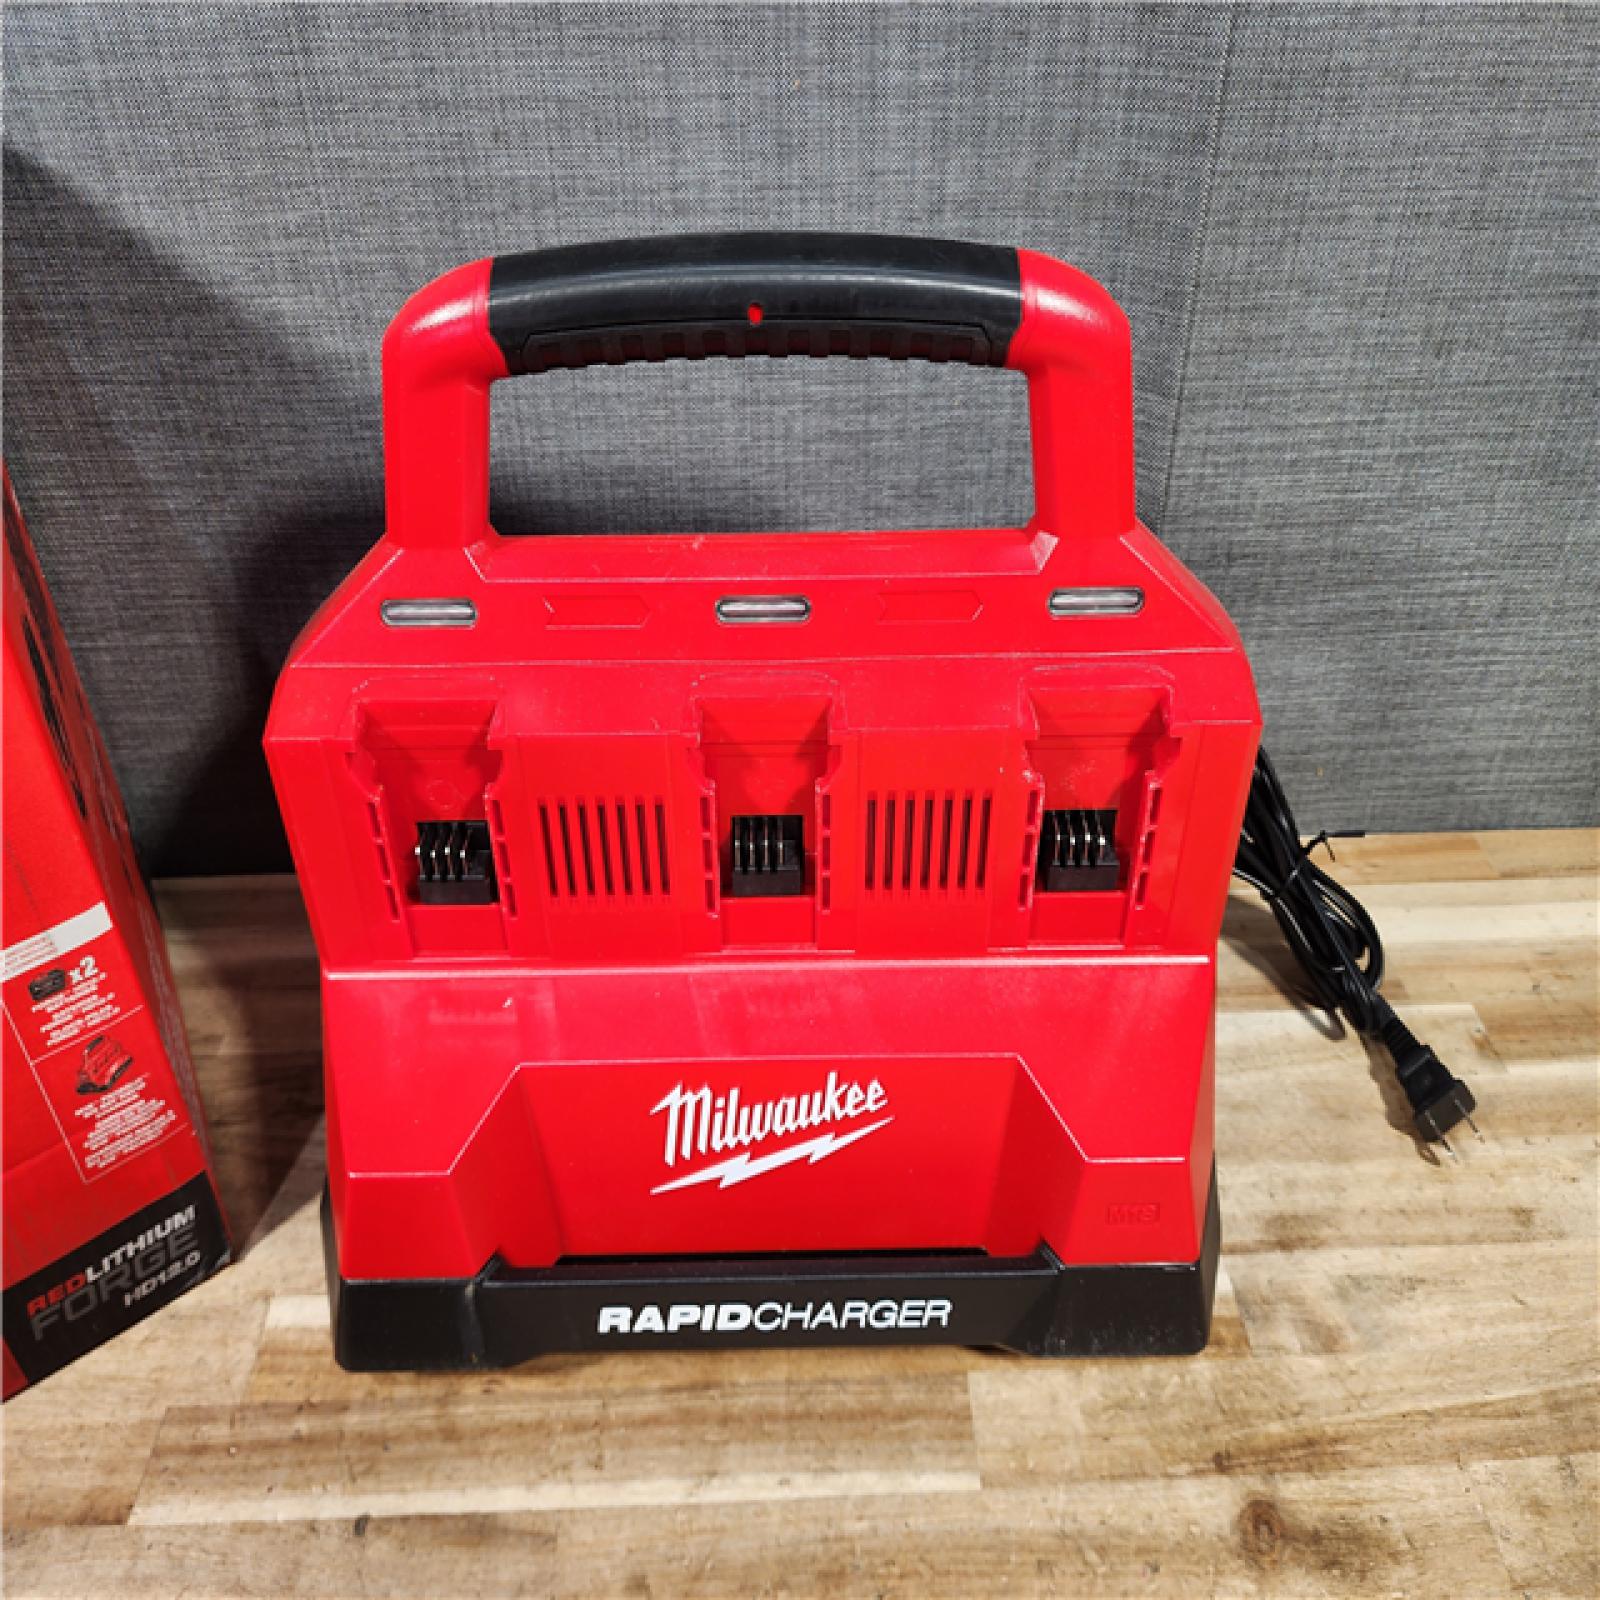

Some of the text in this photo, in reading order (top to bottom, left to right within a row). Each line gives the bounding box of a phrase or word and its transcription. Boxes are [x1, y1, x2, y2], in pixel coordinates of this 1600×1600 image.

[649, 1070, 888, 1167] Milwaukee
[30, 1224, 198, 1341] FORGE
[598, 1299, 952, 1333] RAPIDCHARGER
